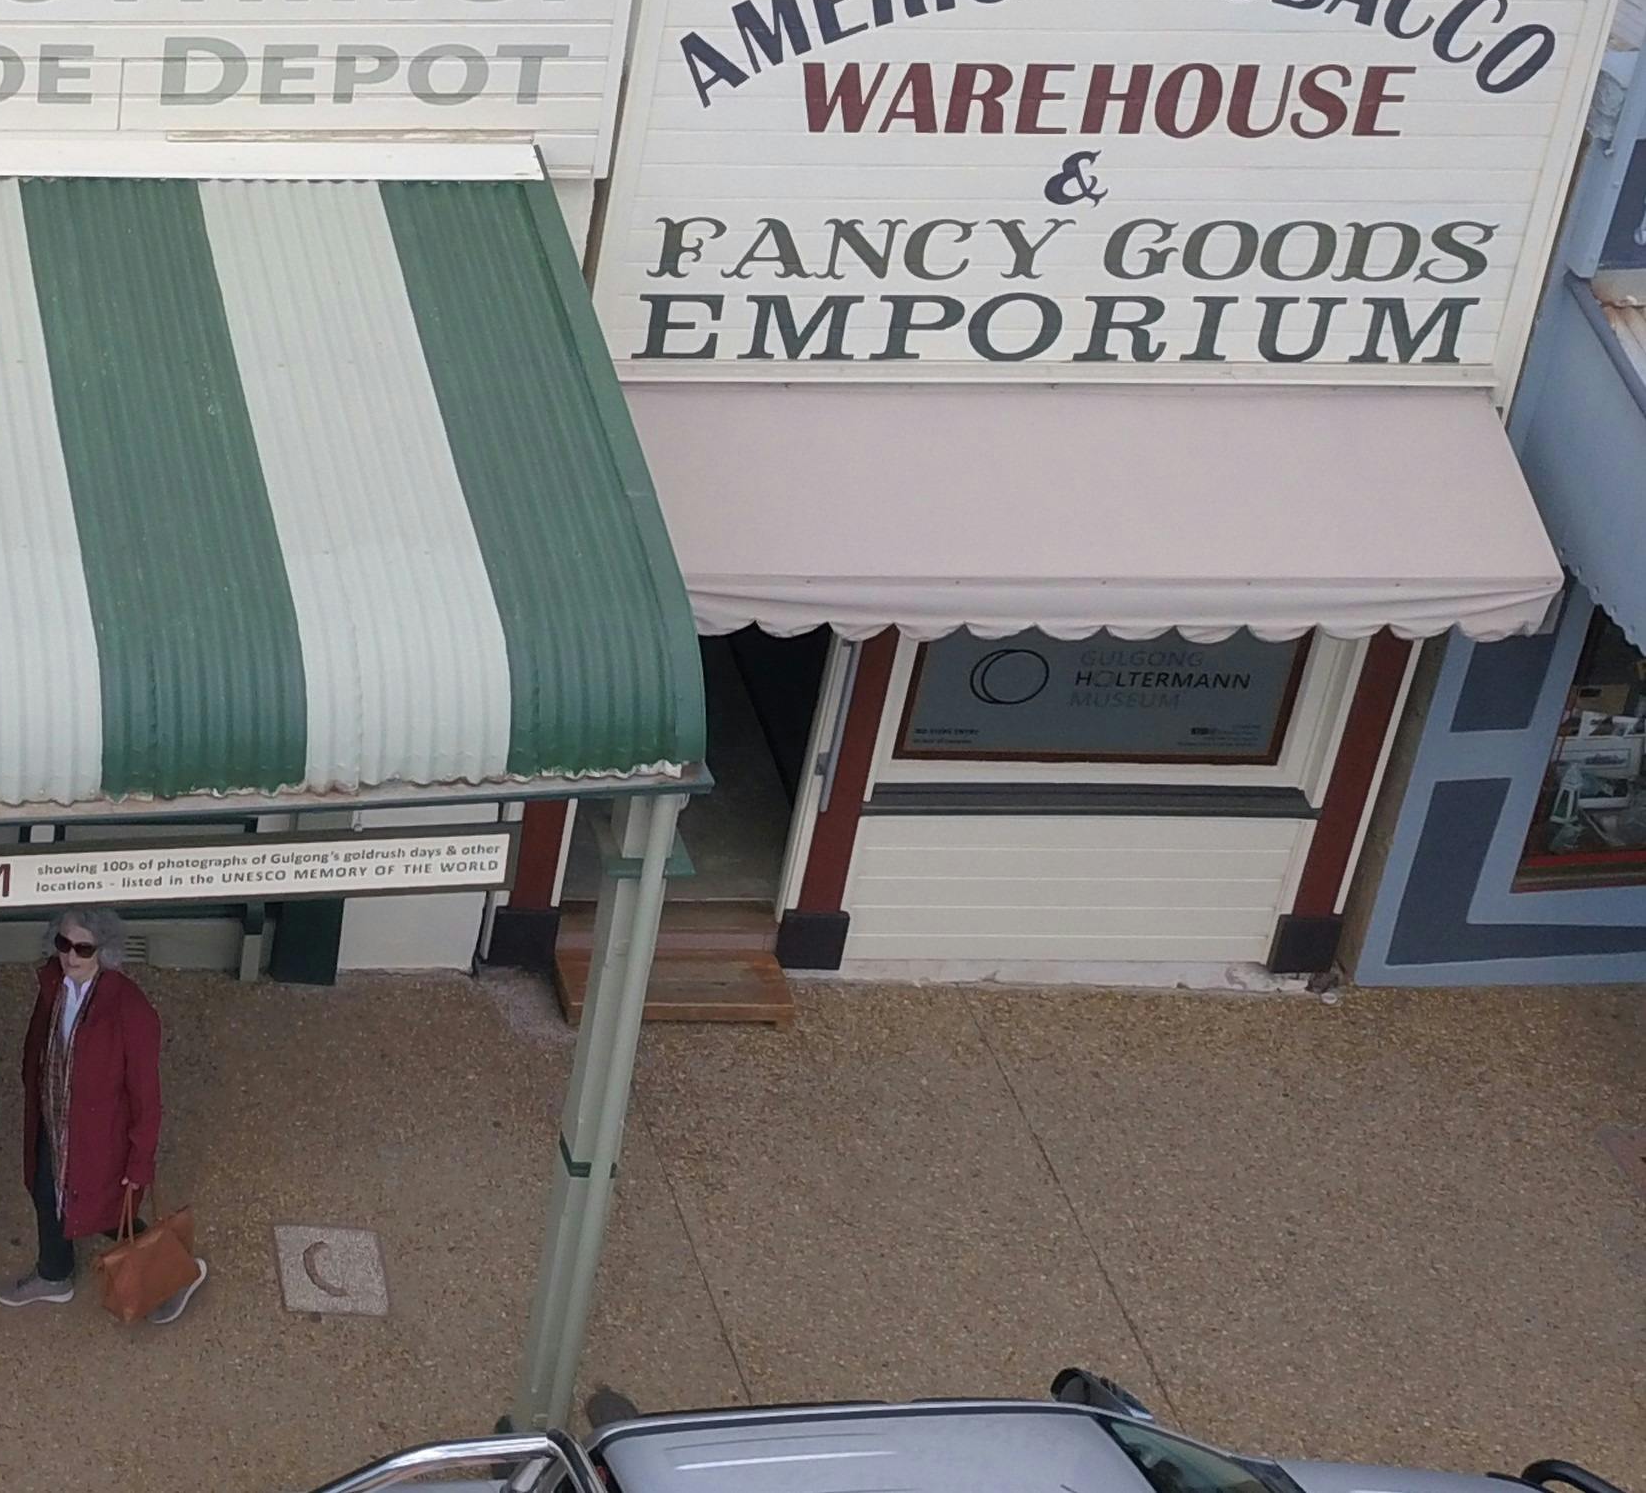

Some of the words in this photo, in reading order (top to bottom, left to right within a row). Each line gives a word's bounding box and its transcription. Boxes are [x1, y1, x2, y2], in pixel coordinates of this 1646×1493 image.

[154, 36, 570, 105] DEPOT
[803, 62, 1415, 139] WAREHOUSE
[1044, 150, 1108, 206] &
[647, 217, 1074, 280] FANCY
[1104, 218, 1500, 283] GOODS
[632, 293, 1480, 365] EMPORIUM
[1074, 670, 1251, 689] HOLTERMANN
[1080, 650, 1204, 668] GULGONG
[1067, 691, 1181, 708] MUSEUM
[36, 878, 103, 893] locations
[121, 875, 162, 888] listed
[169, 874, 183, 886] in
[189, 872, 214, 885] the
[221, 869, 287, 883] UNESCO
[293, 865, 369, 880] MEMORY
[374, 864, 395, 877] OF
[403, 862, 433, 875] THE
[439, 859, 499, 874] WORLD
[37, 861, 97, 876] showing
[103, 860, 133, 872] 100s
[138, 859, 153, 871] of
[157, 854, 247, 872] photographs
[252, 853, 266, 866] of
[270, 849, 340, 866] Gulgong's
[344, 846, 406, 863] goldrush
[410, 845, 442, 859] days
[446, 844, 457, 857] &
[461, 843, 500, 856] other
